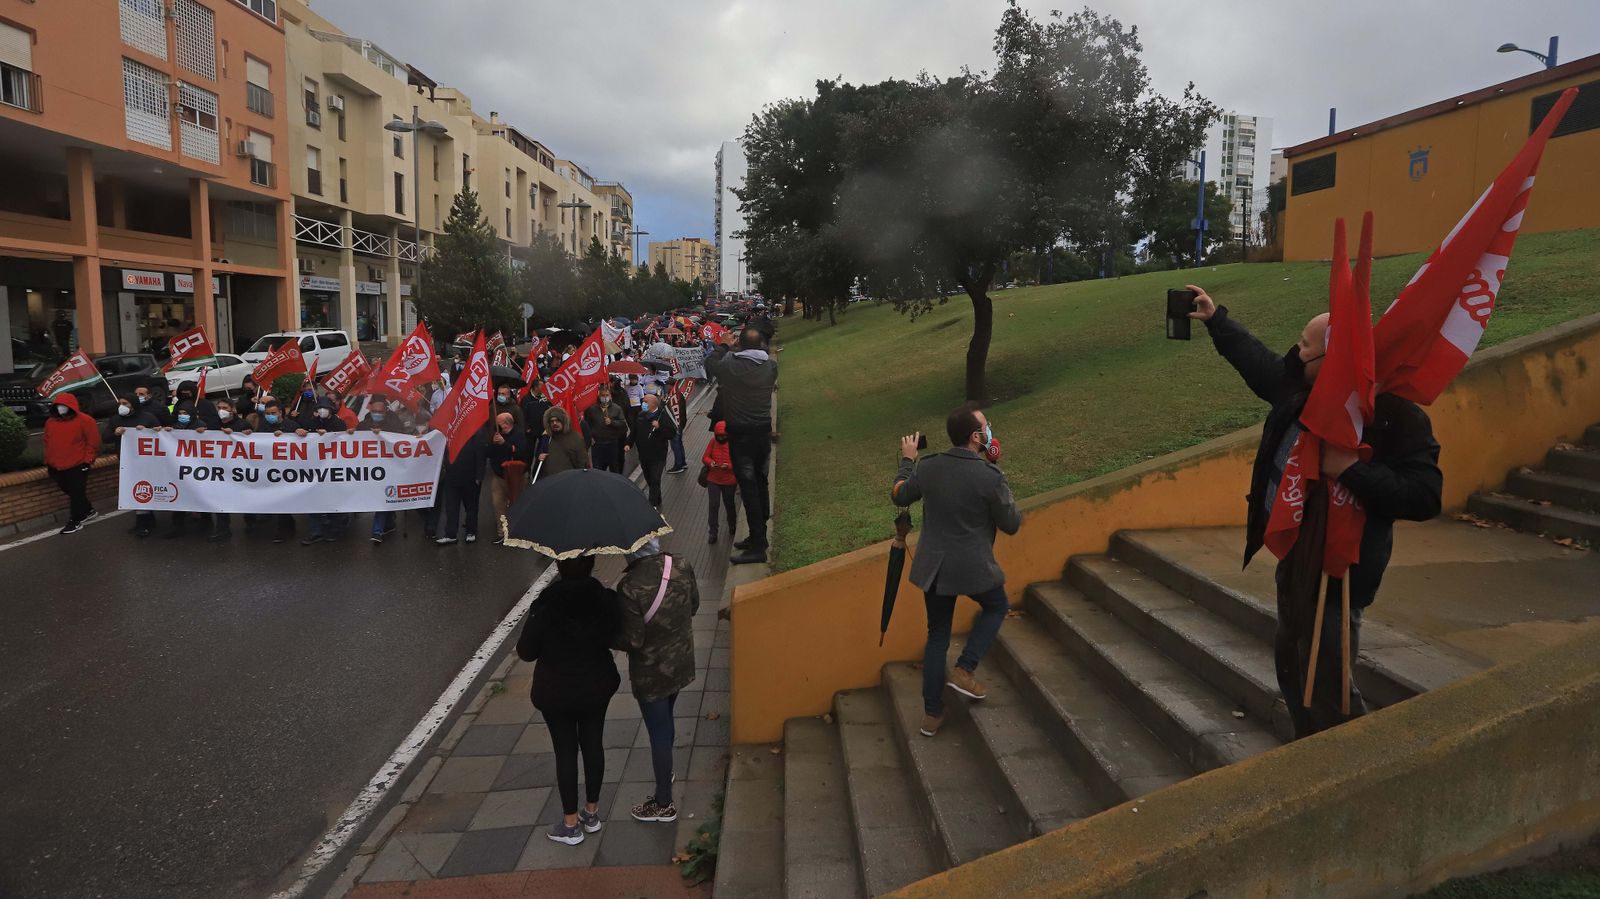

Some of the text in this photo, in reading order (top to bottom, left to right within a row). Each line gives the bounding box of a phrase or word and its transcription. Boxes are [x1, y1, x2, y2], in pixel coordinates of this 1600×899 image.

[135, 275, 161, 286] YAMAHA
[138, 437, 433, 461] EL METAL EN HUELGA
[179, 465, 386, 483] POR SU CONVENIO
[154, 485, 168, 493] FICA
[1282, 474, 1304, 522] Agro
